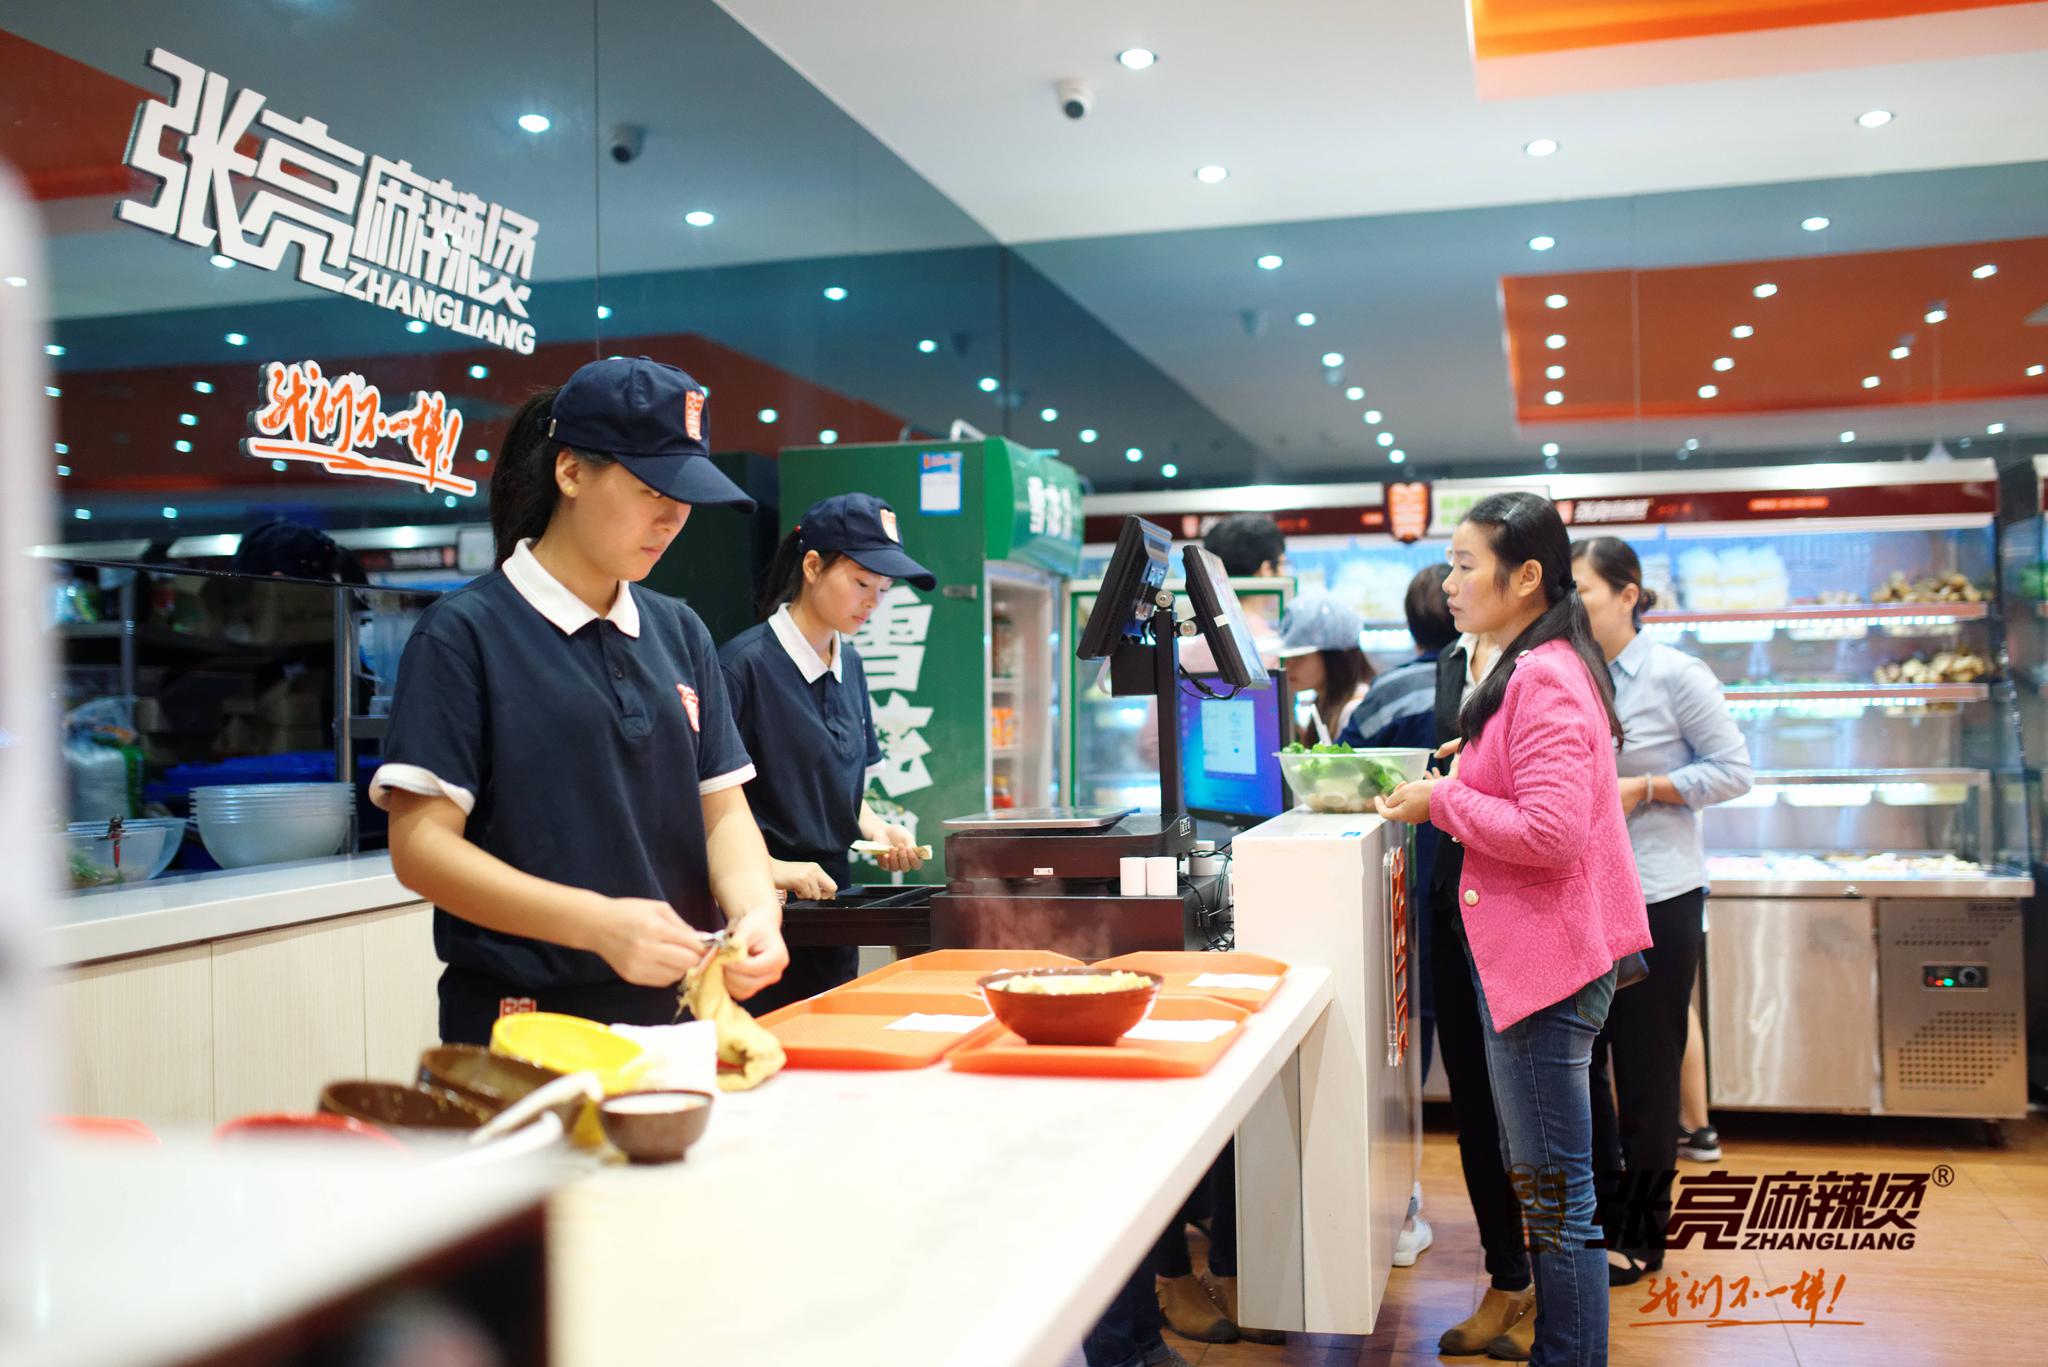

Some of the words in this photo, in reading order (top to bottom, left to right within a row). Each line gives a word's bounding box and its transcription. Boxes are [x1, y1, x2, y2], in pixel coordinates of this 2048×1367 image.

[115, 46, 540, 319] 张亮麻辣烫
[342, 262, 537, 356] ZHANGLIANG
